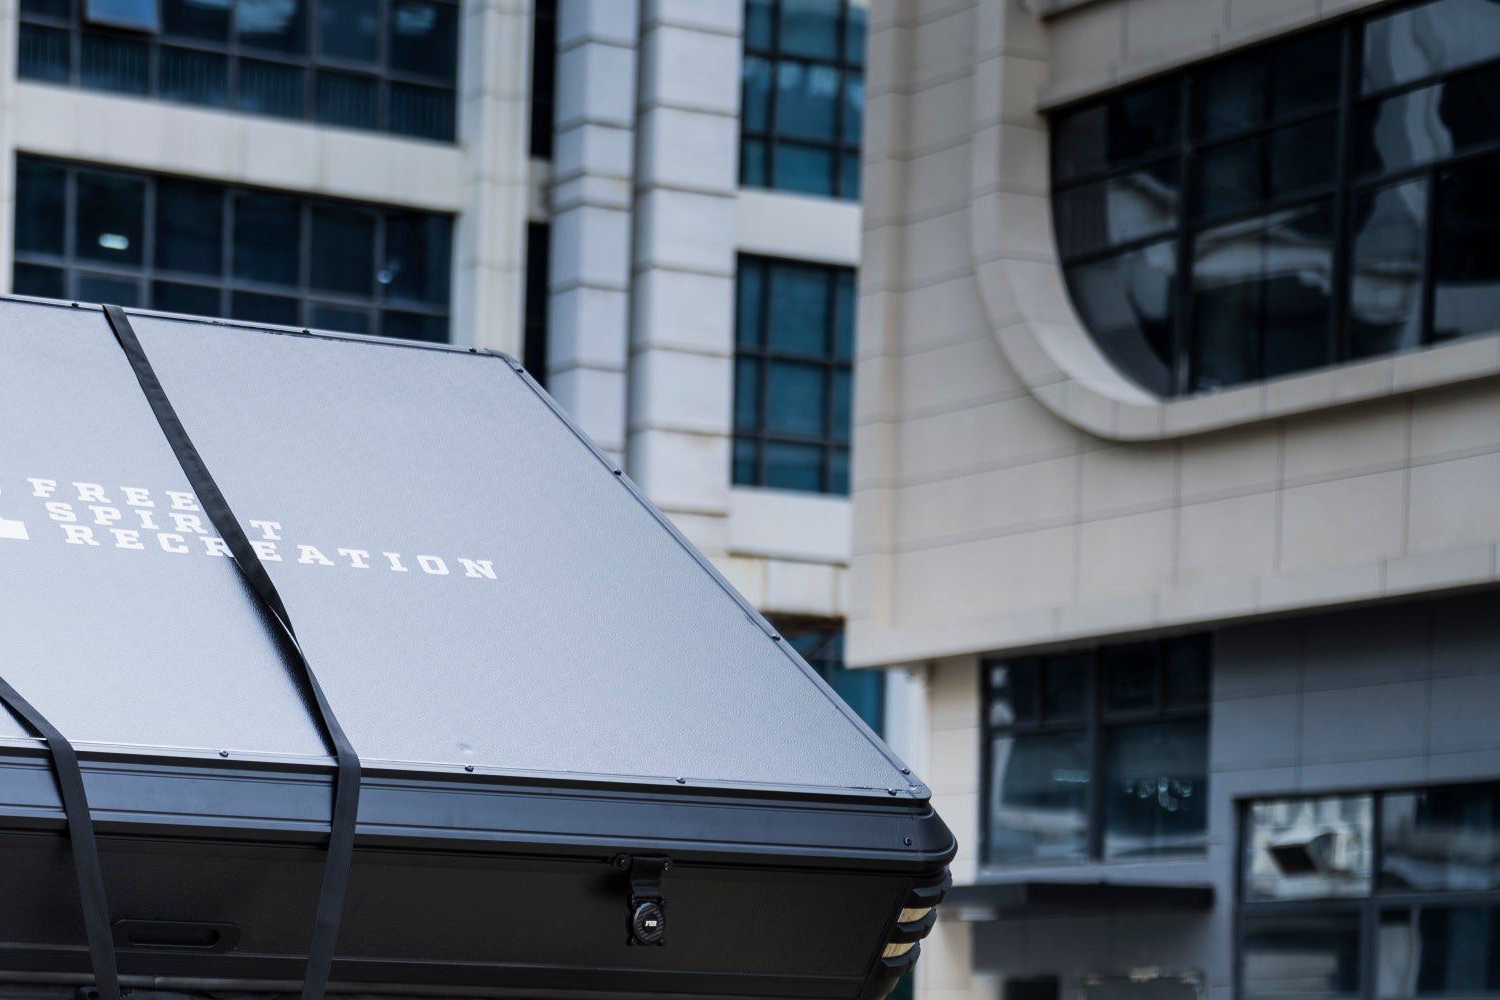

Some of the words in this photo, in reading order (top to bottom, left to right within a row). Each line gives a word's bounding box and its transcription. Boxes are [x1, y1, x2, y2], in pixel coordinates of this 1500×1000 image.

[27, 477, 201, 512] FREE
[45, 501, 283, 541] SPIRT
[60, 524, 498, 580] RECREATION
